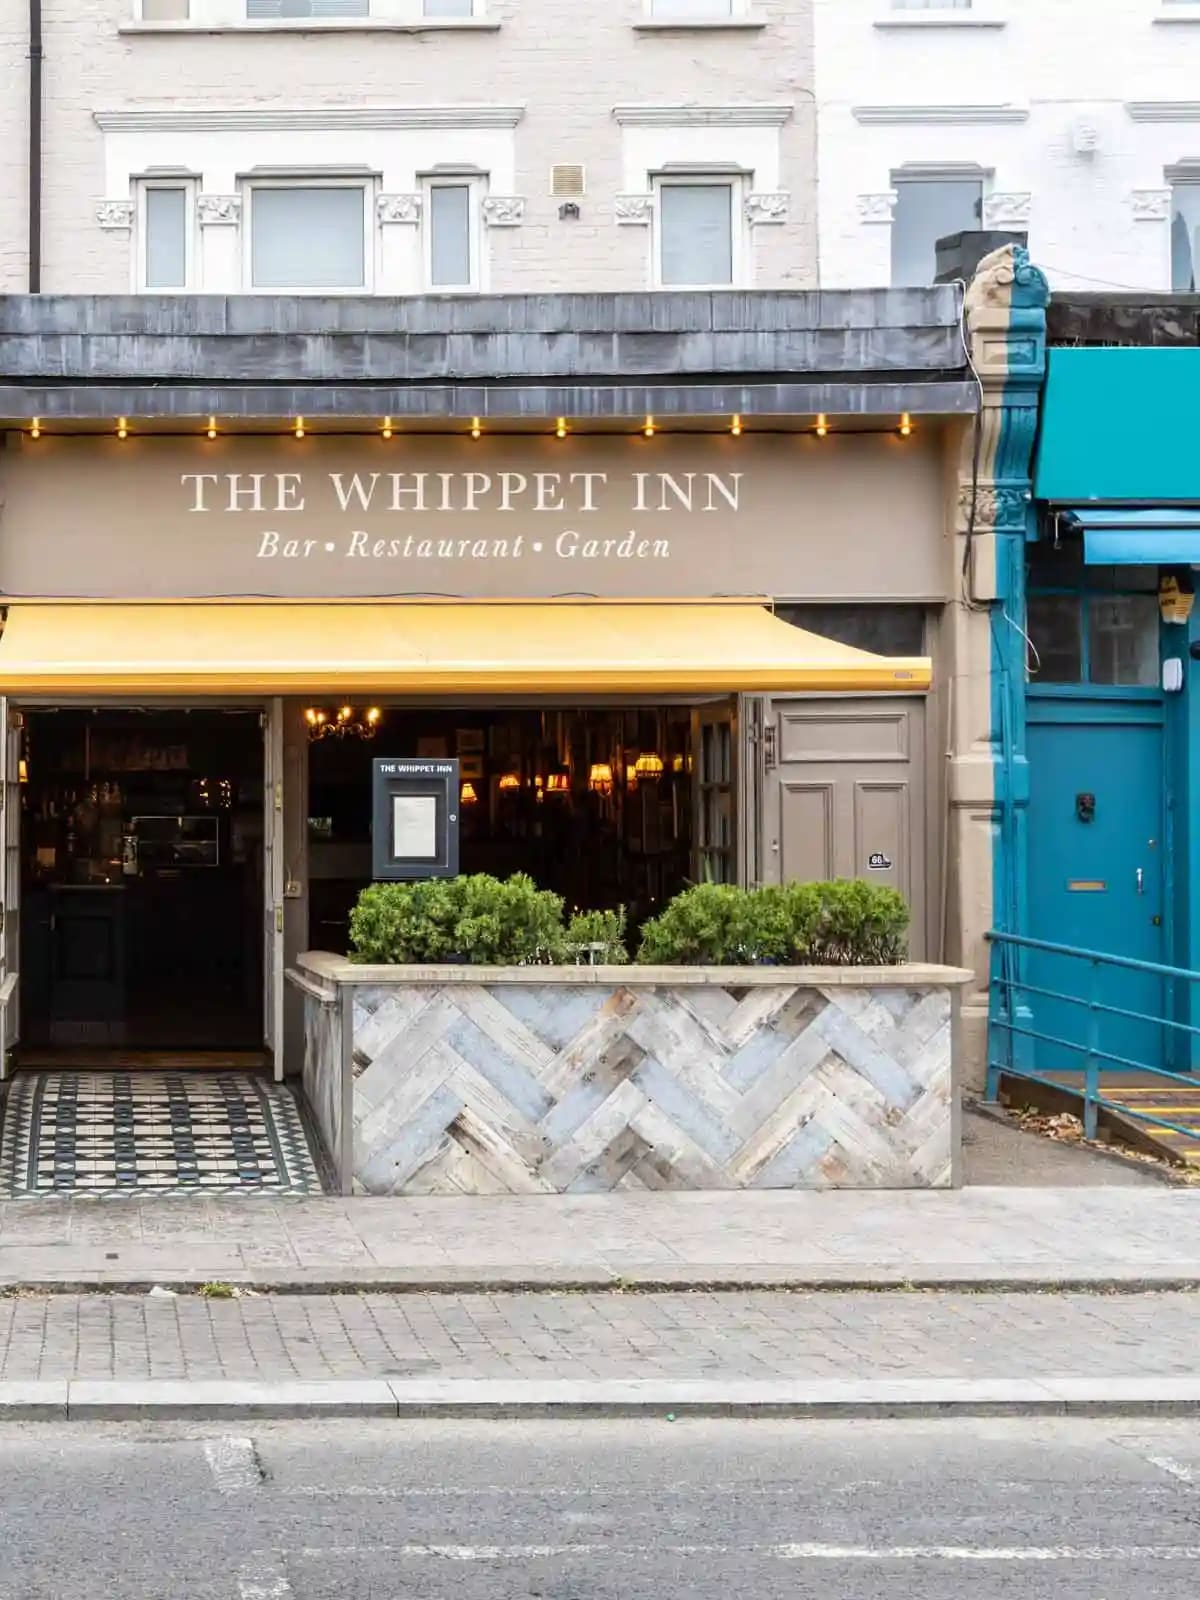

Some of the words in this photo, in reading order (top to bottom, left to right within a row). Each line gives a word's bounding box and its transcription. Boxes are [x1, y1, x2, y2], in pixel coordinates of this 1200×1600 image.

[181, 473, 305, 512] THE
[328, 472, 608, 512] WHIPPET
[631, 473, 744, 512] INN
[256, 530, 318, 558] Bar
[346, 530, 524, 558] Restaurant
[555, 530, 671, 558] Garden
[380, 764, 396, 773] THE
[398, 764, 435, 773] WHIPPET
[436, 765, 453, 773] INN
